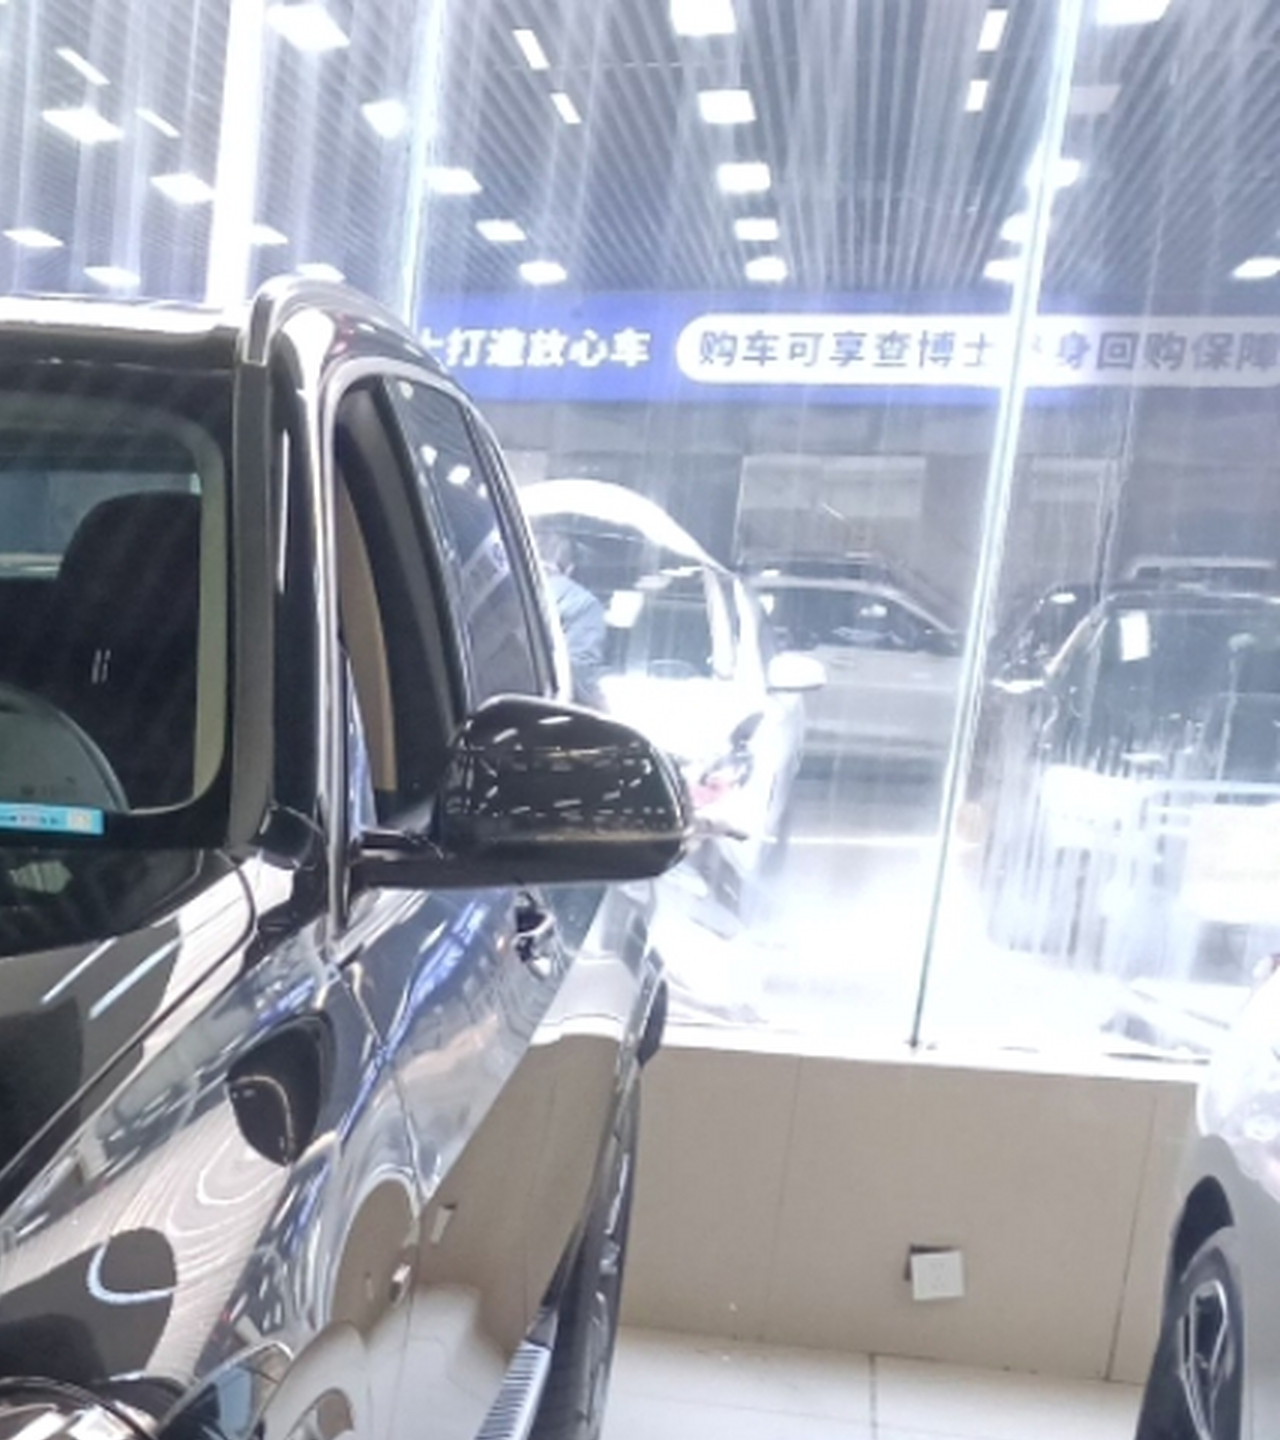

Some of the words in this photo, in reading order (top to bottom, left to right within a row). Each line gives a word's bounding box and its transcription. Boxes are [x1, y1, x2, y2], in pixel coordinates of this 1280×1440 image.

[700, 331, 1280, 371] 购车可享查博士身回购保障
